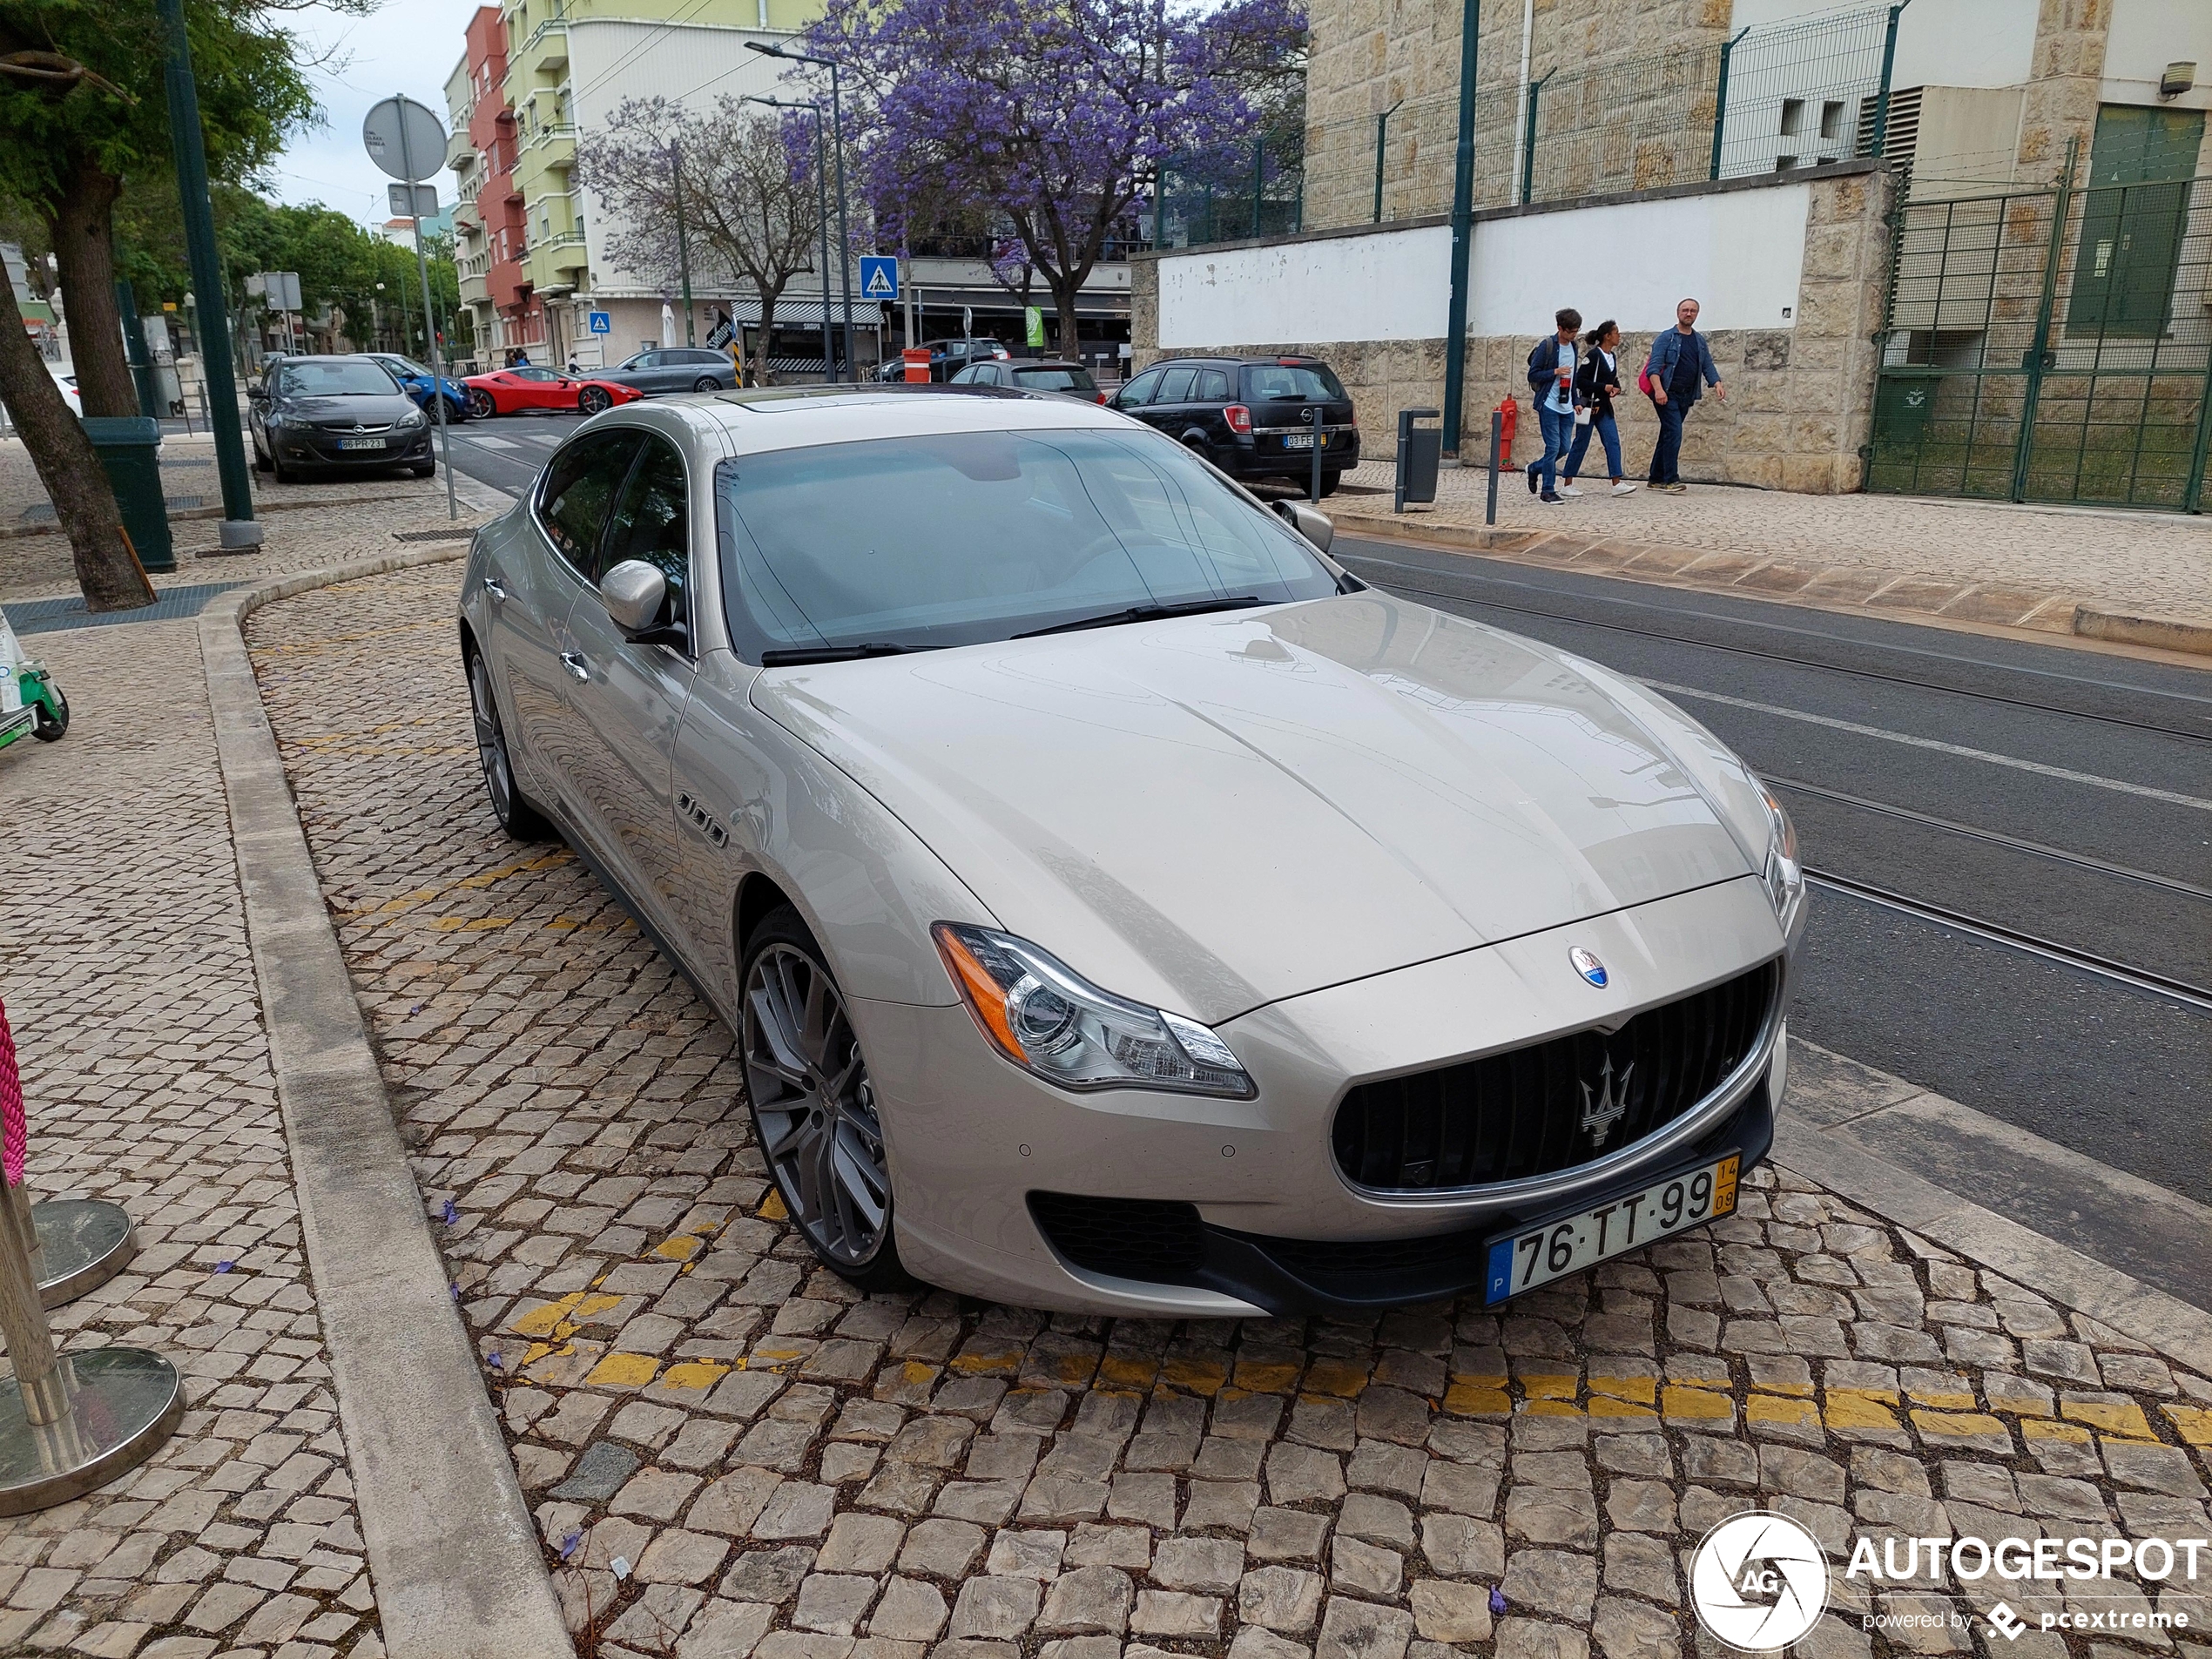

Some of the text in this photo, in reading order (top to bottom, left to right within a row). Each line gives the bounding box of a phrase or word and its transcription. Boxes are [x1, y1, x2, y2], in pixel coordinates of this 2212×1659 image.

[1720, 1160, 1737, 1180] 14
[1715, 1190, 1734, 1211] 09
[1494, 1277, 1504, 1292] P
